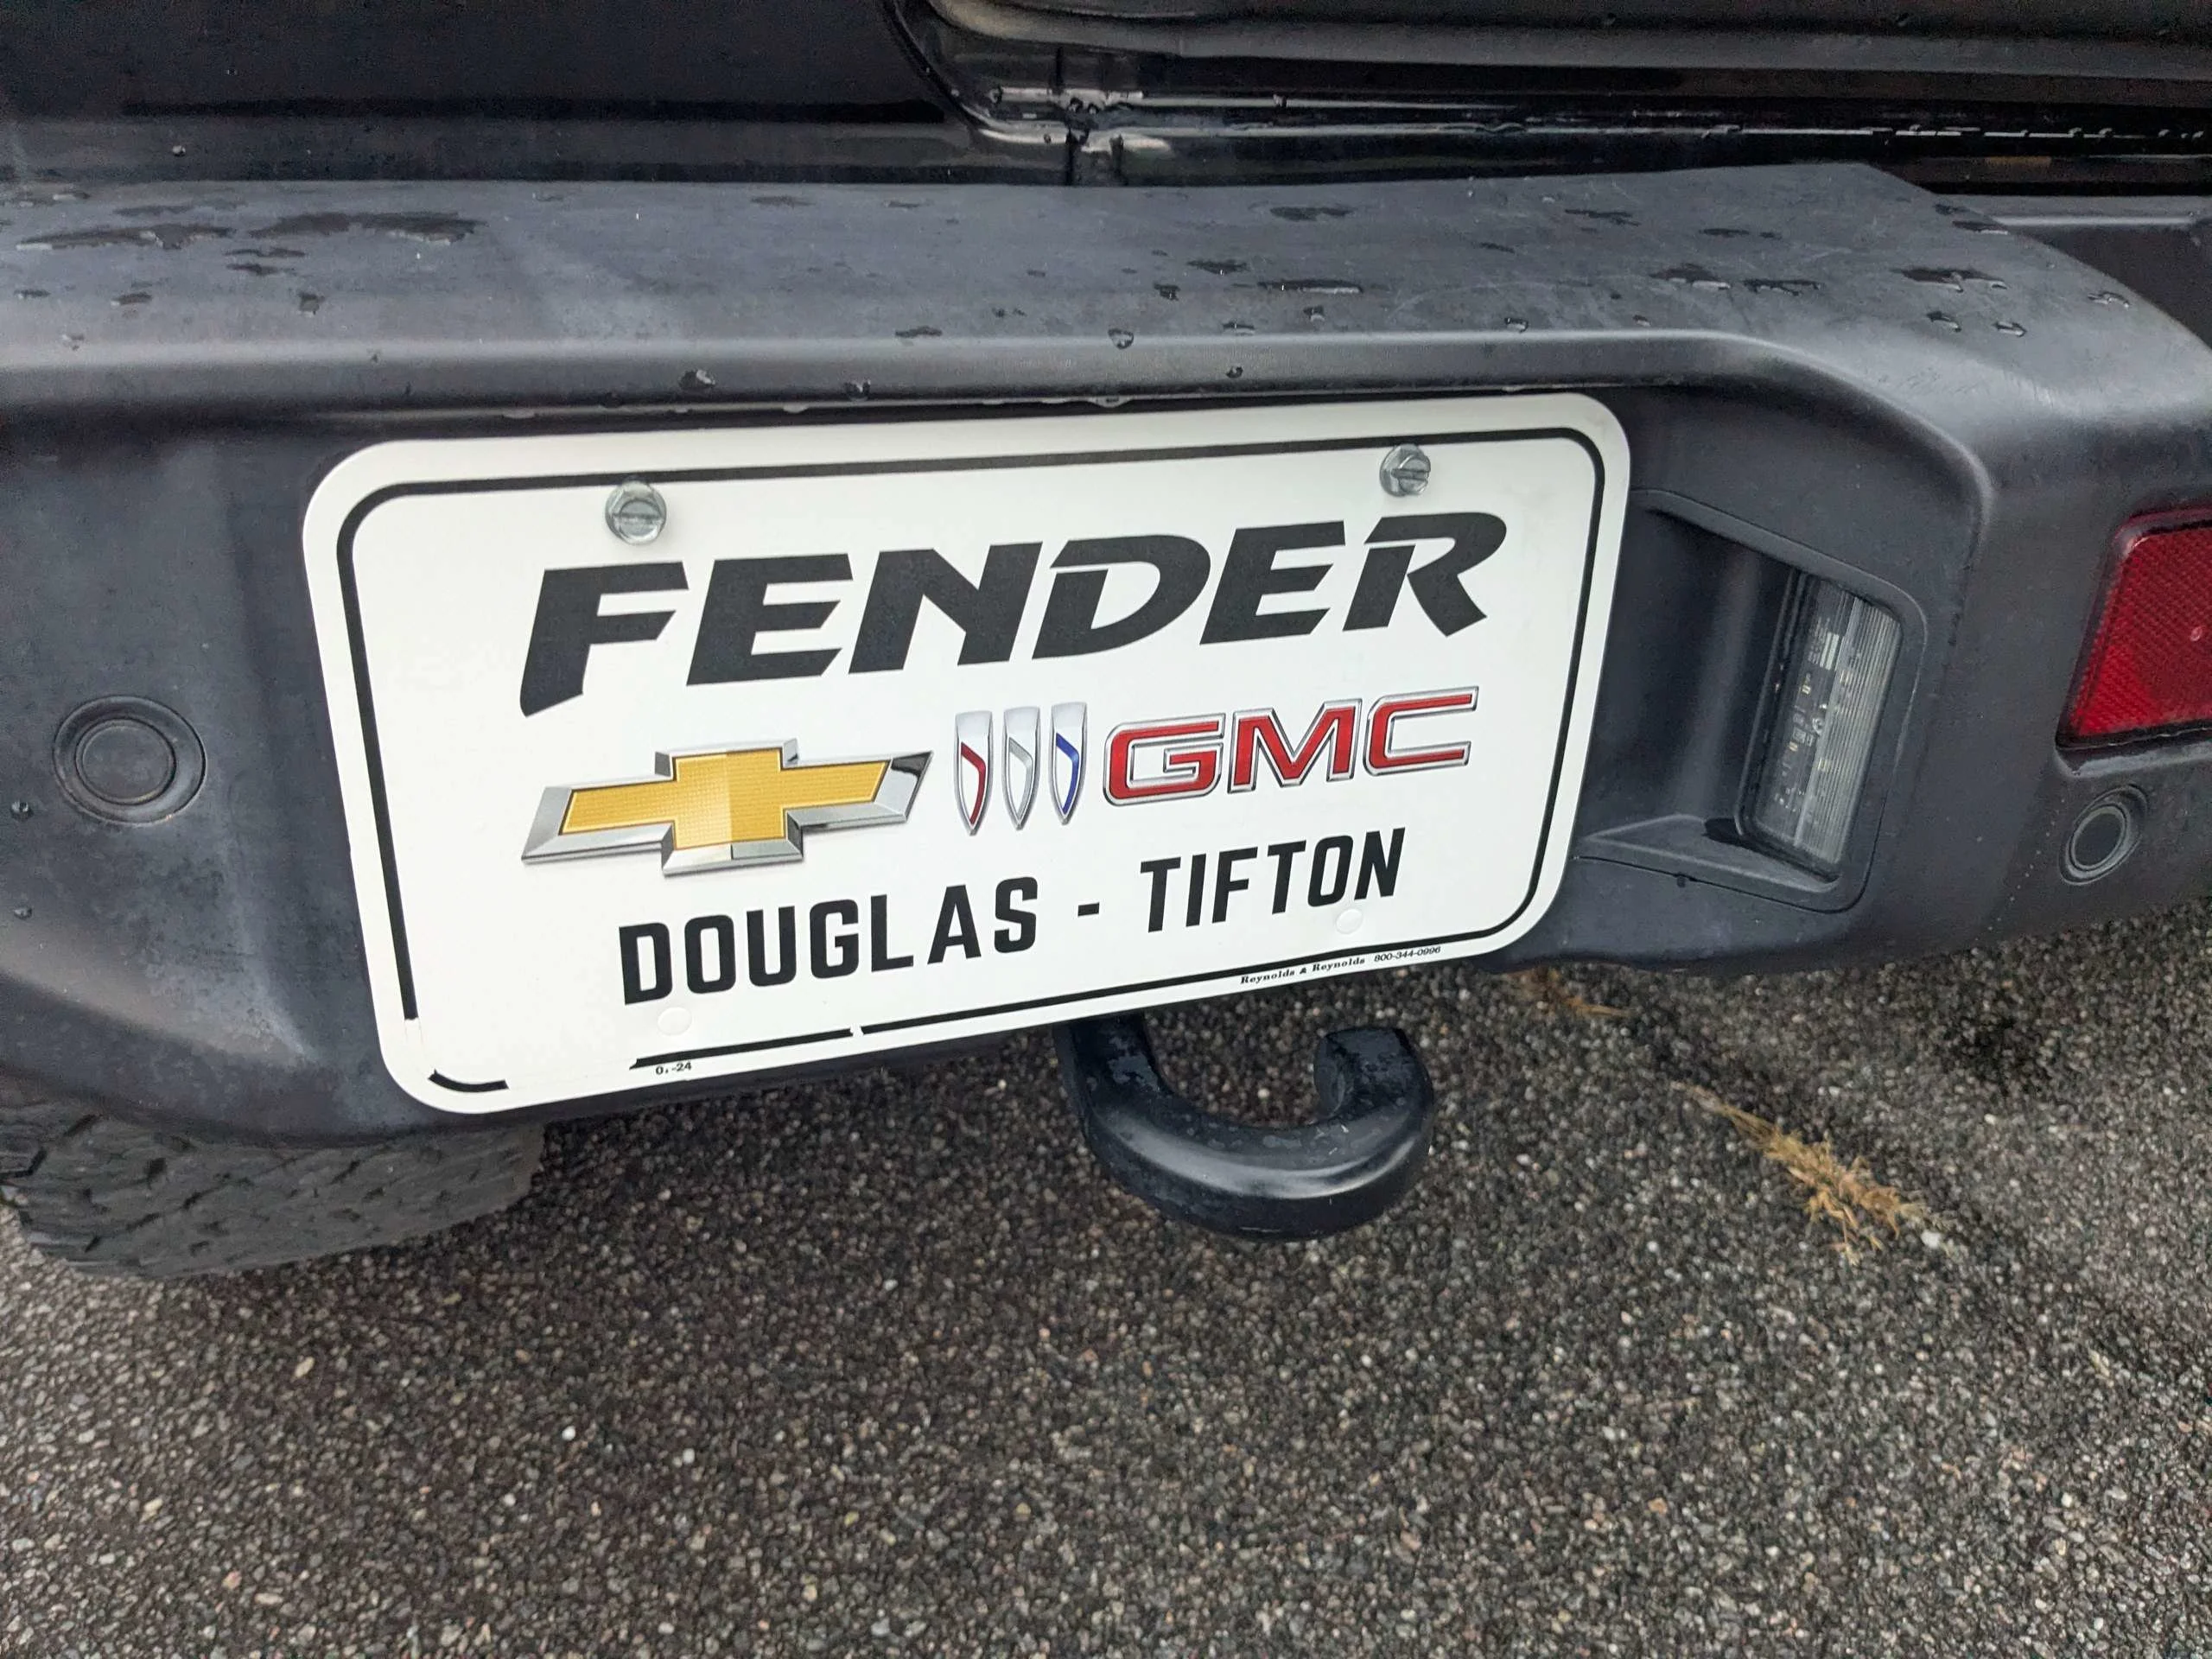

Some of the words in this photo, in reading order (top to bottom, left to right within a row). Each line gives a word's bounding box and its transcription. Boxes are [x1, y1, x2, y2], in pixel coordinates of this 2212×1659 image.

[519, 512, 1507, 717] FENDER
[1103, 686, 1479, 806] GMC
[619, 876, 1039, 1006] DOUGLAS
[1077, 902, 1100, 917] -
[1140, 827, 1406, 933] TIFTON
[1240, 969, 1295, 984] Reynolds
[1299, 966, 1307, 976] &
[1312, 957, 1365, 972] Reynolds
